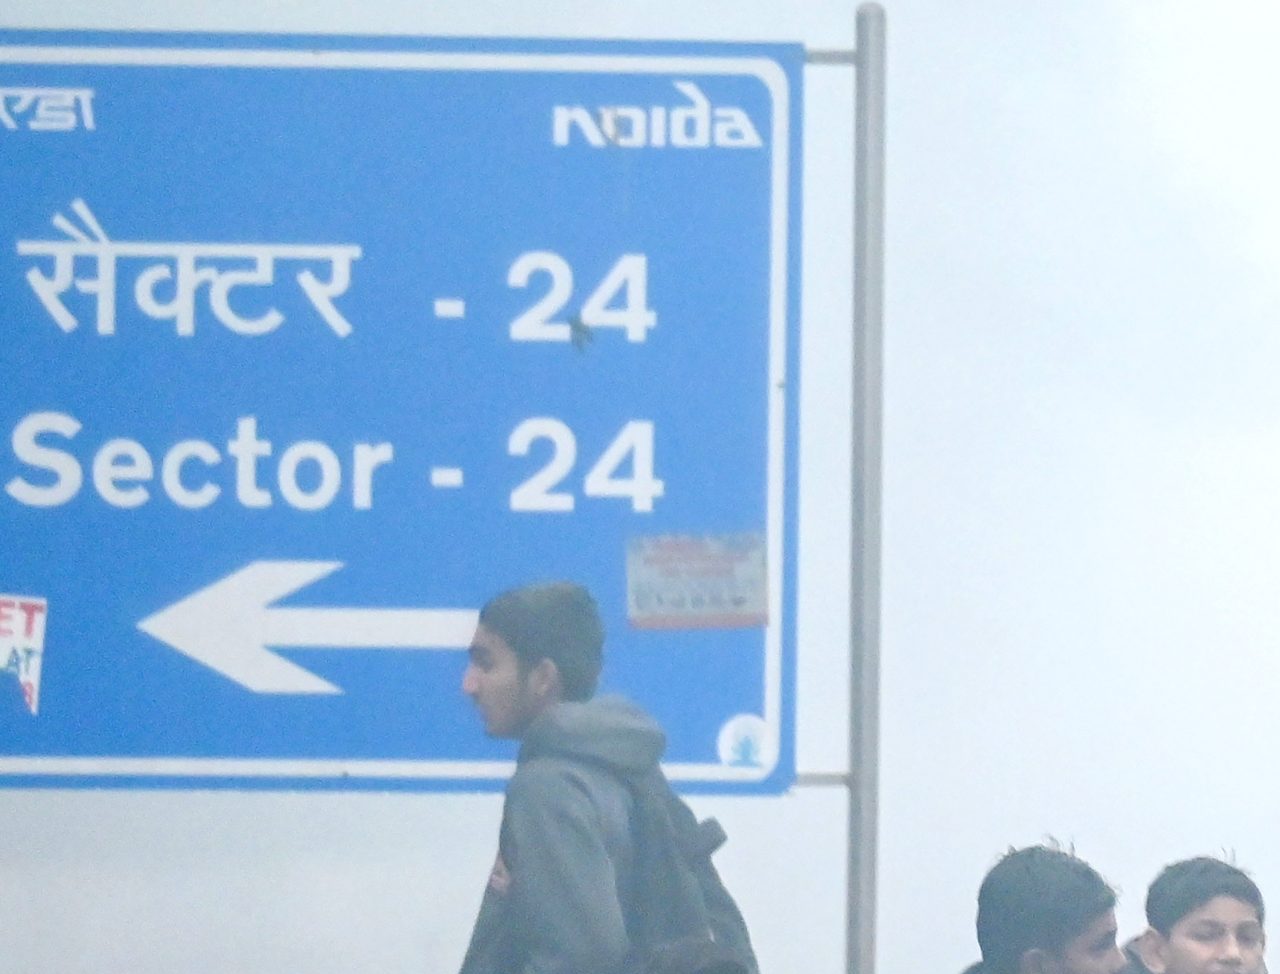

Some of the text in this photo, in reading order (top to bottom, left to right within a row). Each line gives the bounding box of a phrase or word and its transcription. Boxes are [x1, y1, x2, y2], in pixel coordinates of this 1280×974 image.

[16, 197, 362, 338] सैक्टर
[506, 249, 657, 344] 24
[5, 412, 666, 514] Sector - 24
